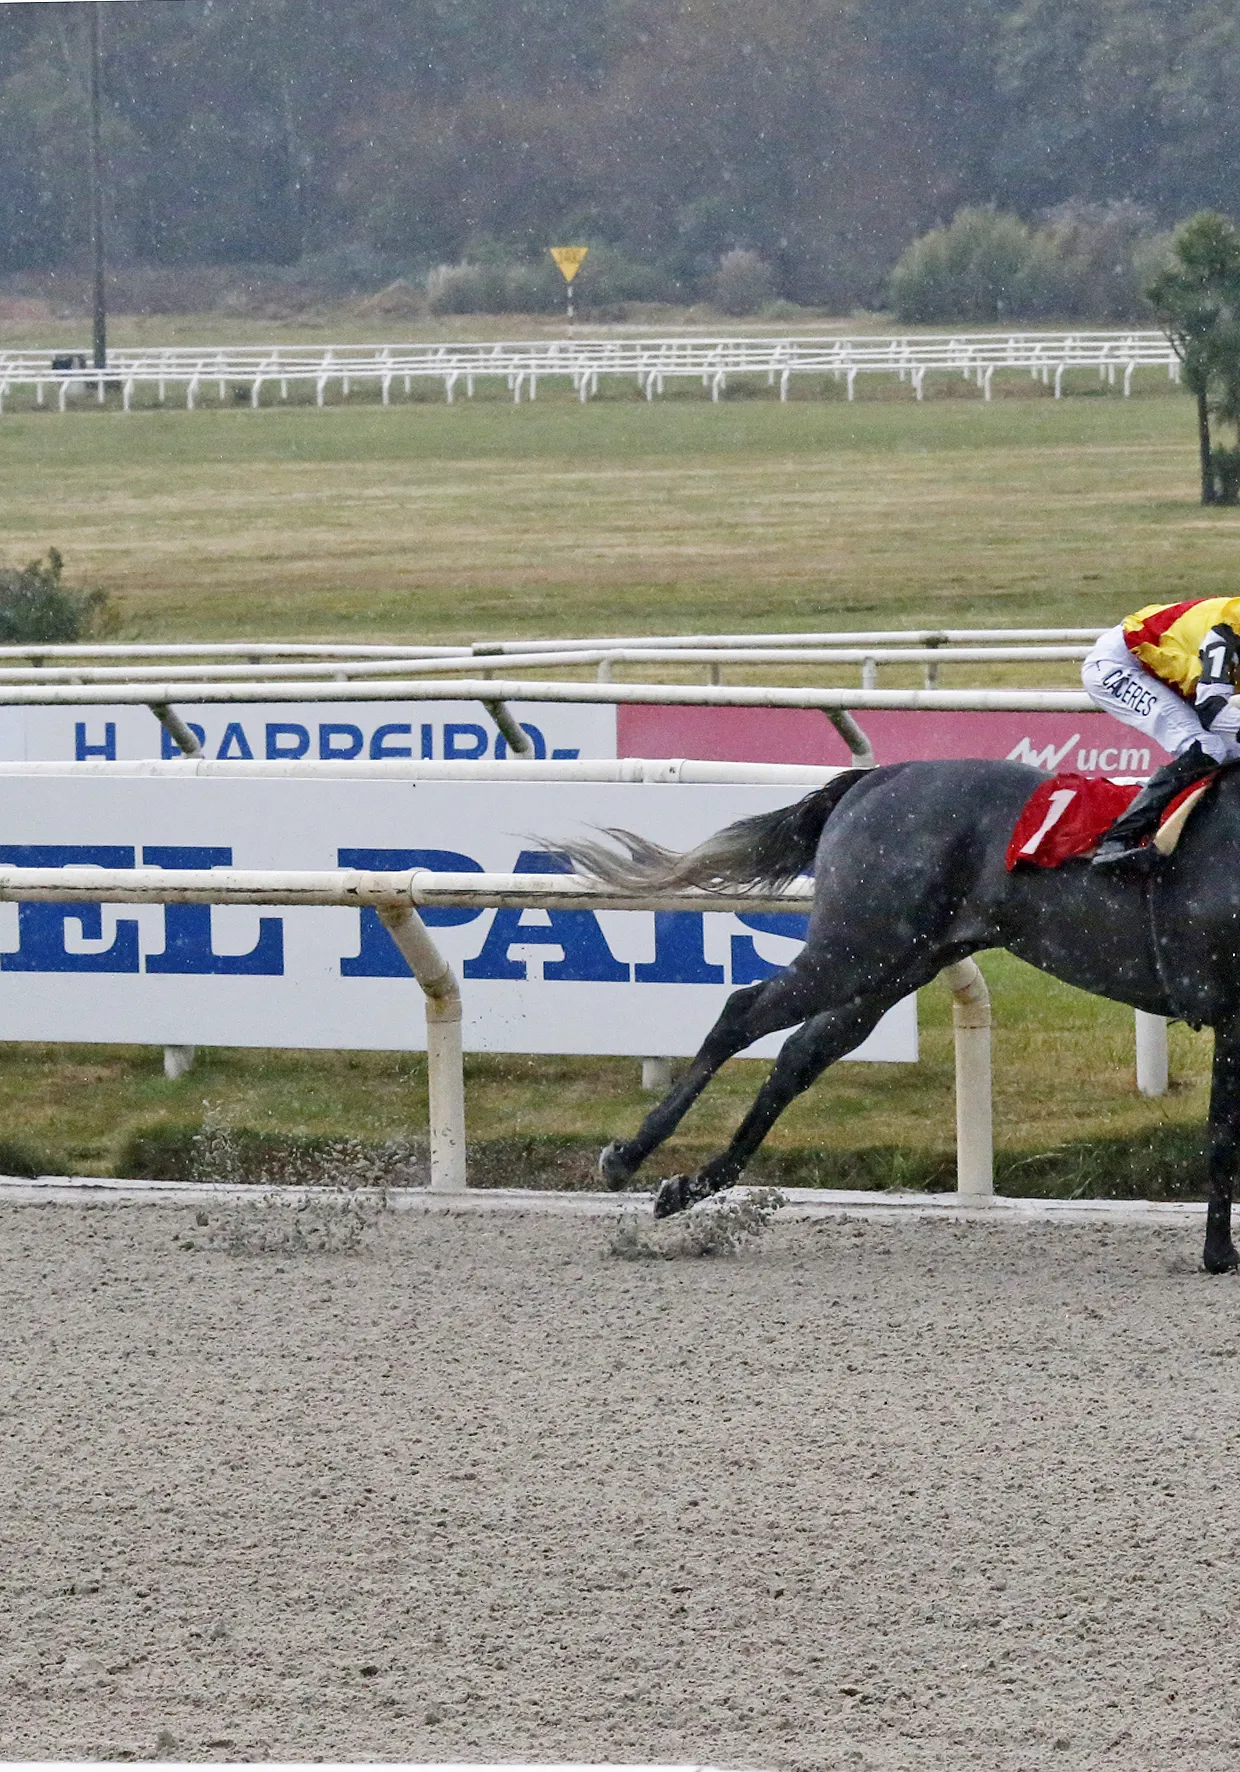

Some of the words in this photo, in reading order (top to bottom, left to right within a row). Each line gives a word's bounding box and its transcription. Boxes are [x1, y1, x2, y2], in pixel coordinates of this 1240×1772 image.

[1208, 645, 1226, 678] 1
[1077, 747, 1150, 771] ucm
[1019, 788, 1077, 855] 1
[0, 844, 284, 976] EL
